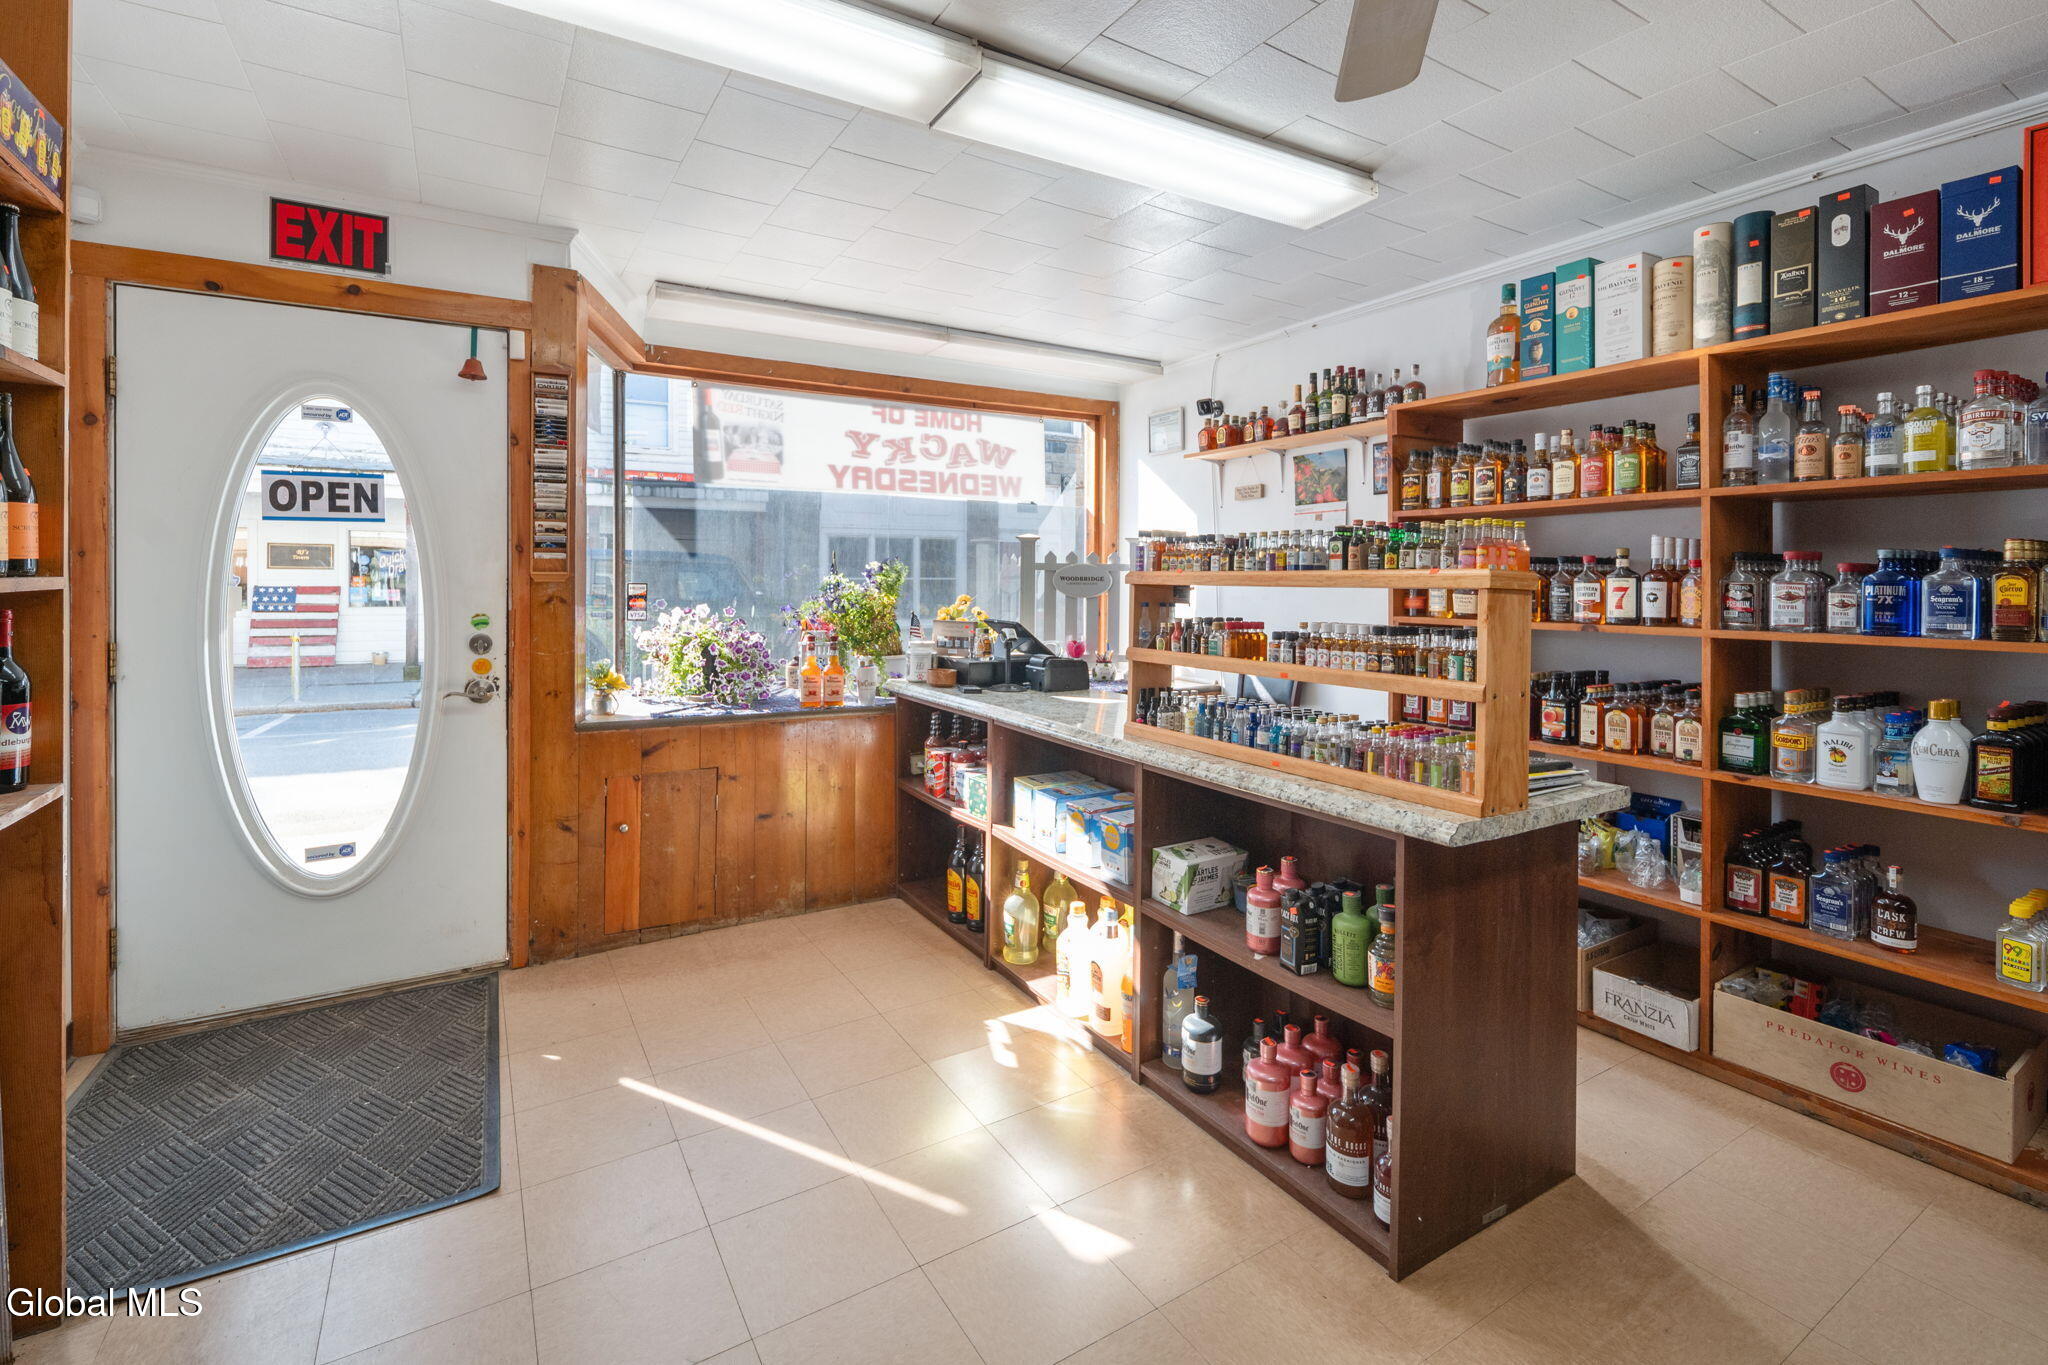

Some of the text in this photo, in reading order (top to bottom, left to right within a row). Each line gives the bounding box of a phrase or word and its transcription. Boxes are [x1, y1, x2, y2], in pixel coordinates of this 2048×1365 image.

[276, 203, 383, 269] EXIT
[1956, 226, 2001, 240] DALMORE
[1883, 245, 1925, 258] DALMORE
[1821, 285, 1861, 297] LAGAVULIN
[1899, 291, 1909, 299] 12
[1613, 308, 1622, 316] 21
[1962, 411, 2000, 422] SMIRNOFF
[1797, 436, 1821, 444] Tito's
[269, 480, 379, 513] OPEN
[380, 550, 405, 566] Quick
[1865, 585, 1907, 597] PLATINUM
[1999, 586, 2023, 594] Cuervo
[1612, 586, 1630, 610] 7
[1877, 596, 1894, 605] 7X
[1775, 735, 1802, 746] GORDON'S
[1824, 739, 1856, 751] MALIBU
[1197, 872, 1219, 885] JAYMES
[1816, 894, 1844, 906] Seagram's
[1878, 908, 1906, 923] CASK
[1877, 926, 1906, 939] CREW
[2004, 943, 2023, 957] 99
[2002, 955, 2029, 966] BANANAS
[1605, 991, 1676, 1030] FRANZIA
[1766, 1020, 1943, 1085] PREDATOR WINES
[1346, 1141, 1367, 1151] ROCKS
